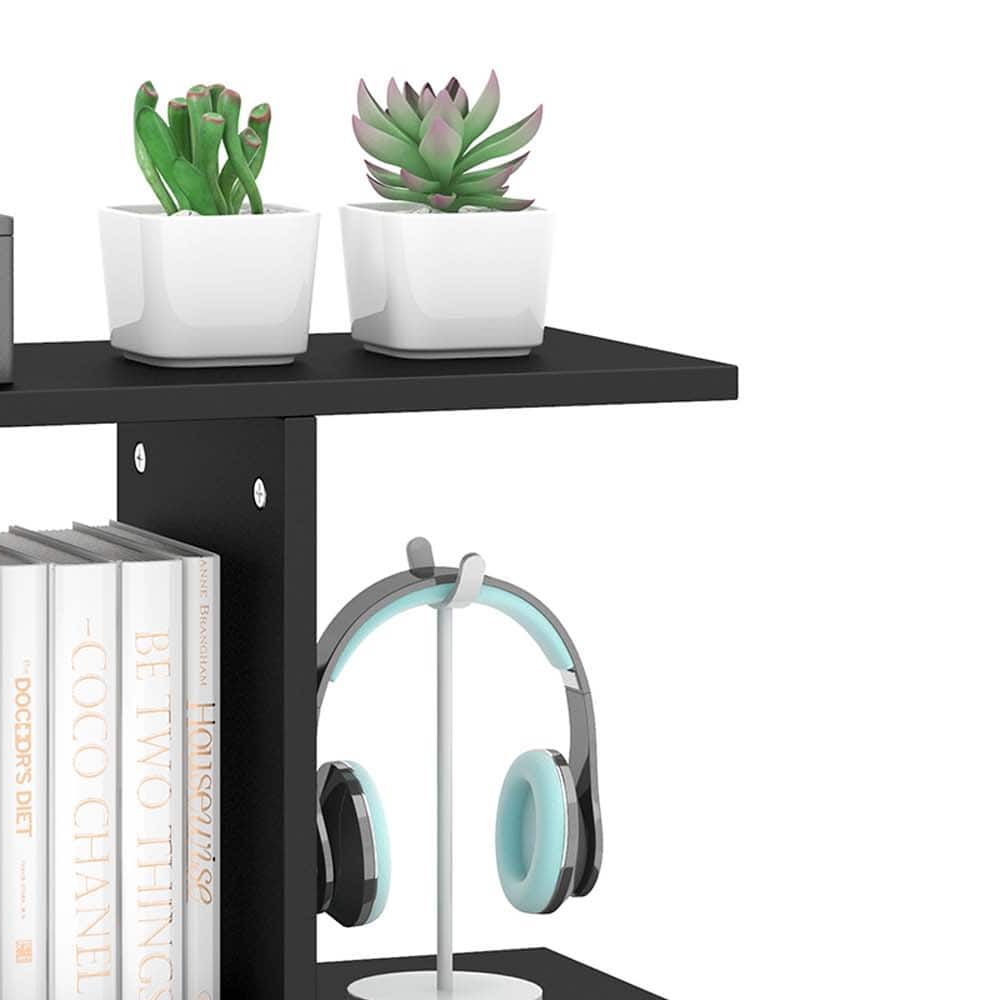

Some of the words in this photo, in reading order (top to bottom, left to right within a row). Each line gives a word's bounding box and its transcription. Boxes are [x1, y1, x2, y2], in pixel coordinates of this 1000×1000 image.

[135, 630, 171, 681] BE
[136, 692, 172, 811] TWO
[15, 790, 32, 838] DIET
[73, 797, 112, 994] CHANEL
